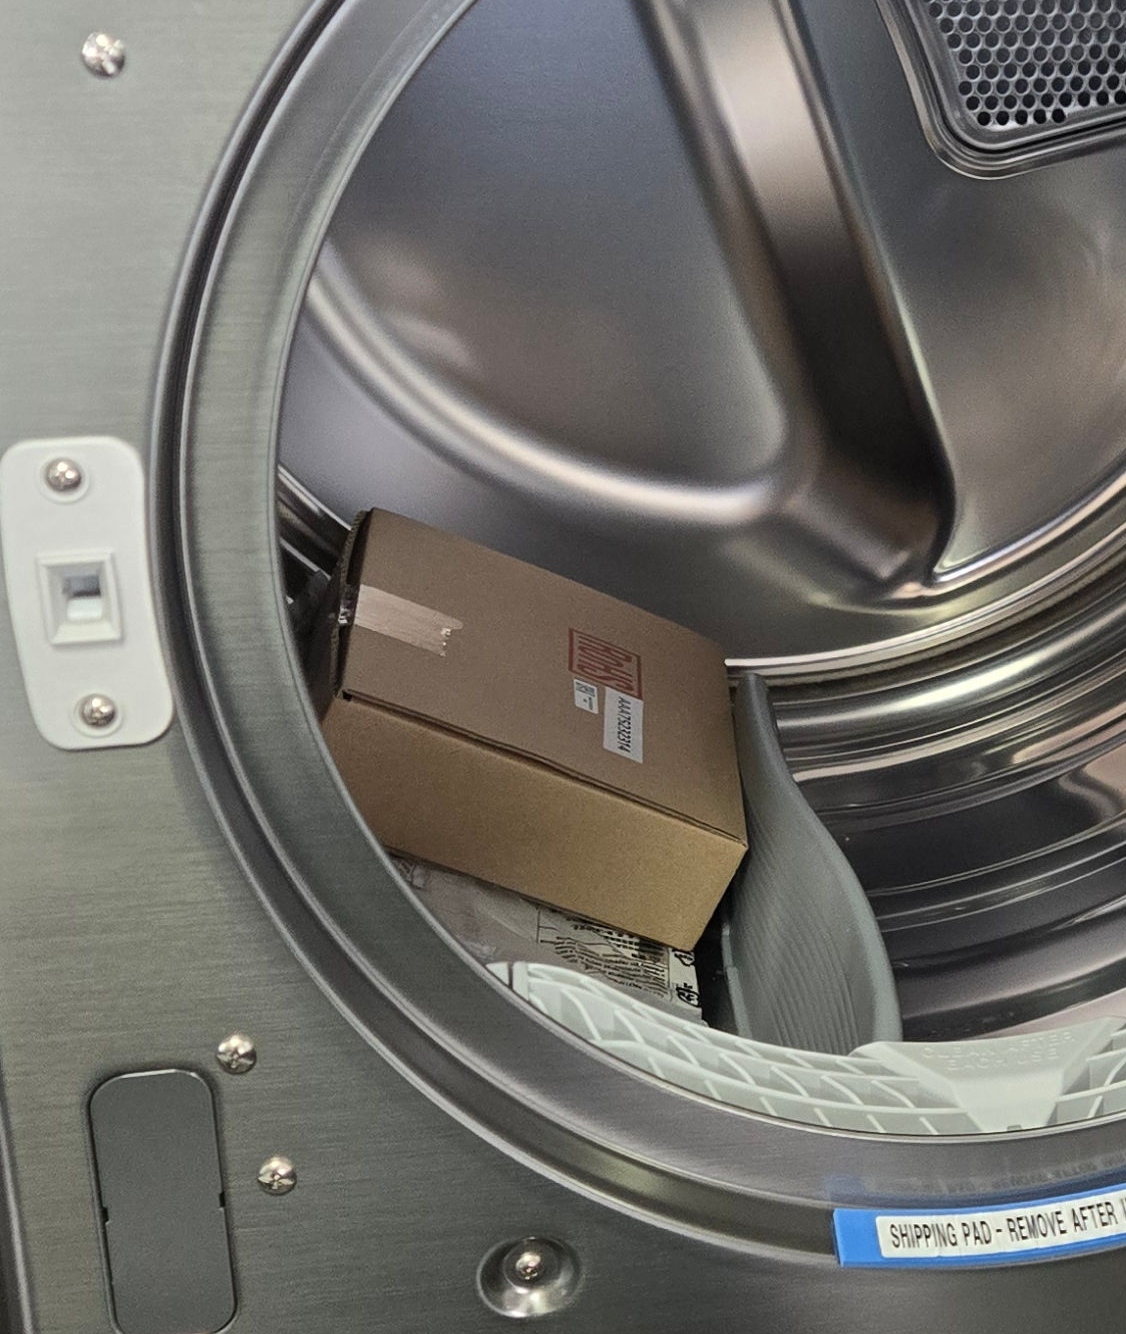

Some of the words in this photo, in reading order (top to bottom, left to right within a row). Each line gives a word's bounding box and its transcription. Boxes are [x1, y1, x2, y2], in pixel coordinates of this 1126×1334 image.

[577, 634, 635, 692] RoHS
[889, 1224, 957, 1249] SHIPPING
[961, 1219, 993, 1247] PAD
[1008, 1209, 1067, 1243] REMOVE
[1073, 1200, 1118, 1233] AFTER
